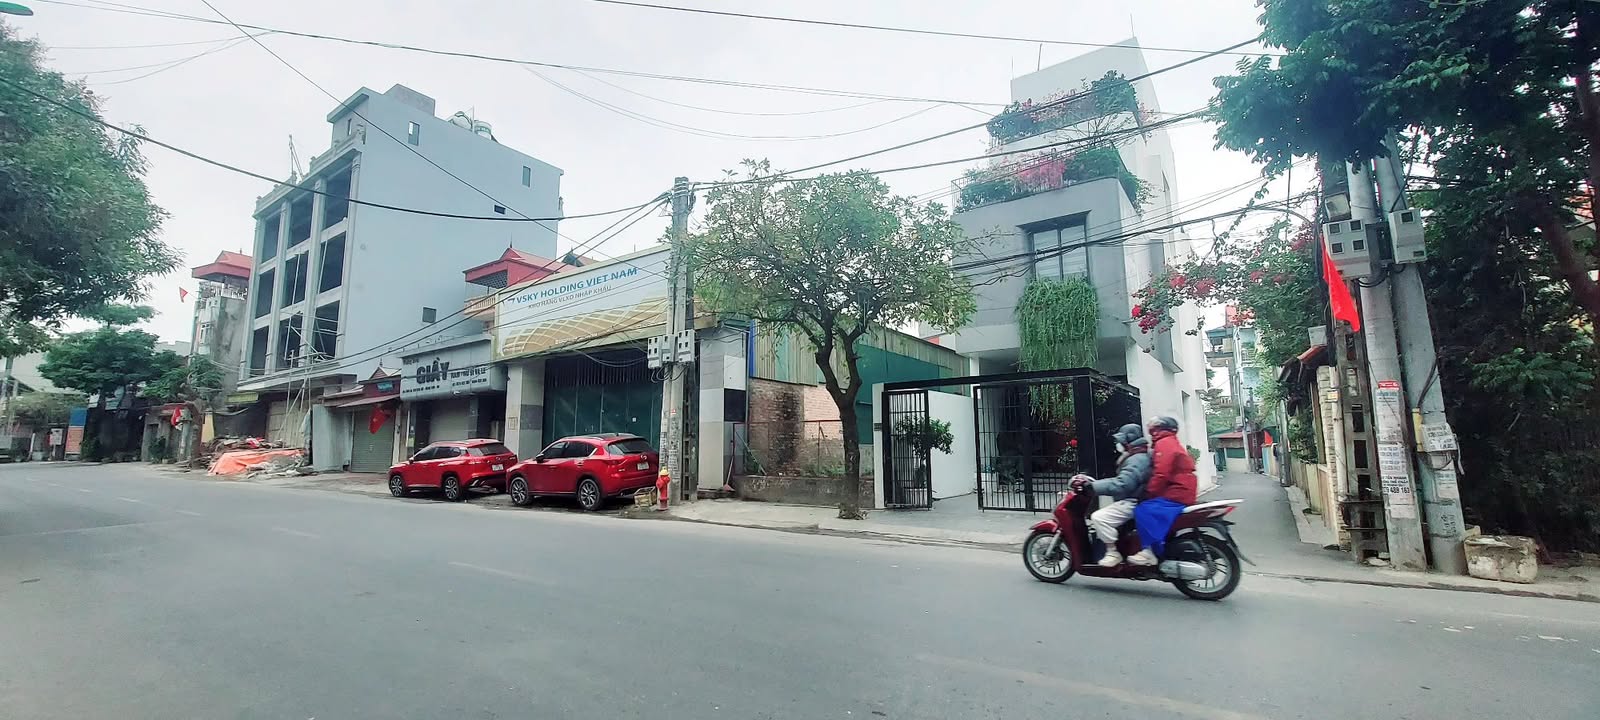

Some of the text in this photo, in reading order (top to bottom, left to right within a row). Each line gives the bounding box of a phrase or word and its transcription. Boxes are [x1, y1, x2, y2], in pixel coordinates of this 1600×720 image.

[540, 281, 584, 299] HOLDING
[586, 274, 608, 288] VIET
[610, 266, 639, 281] NAM
[558, 294, 574, 303] VLXD
